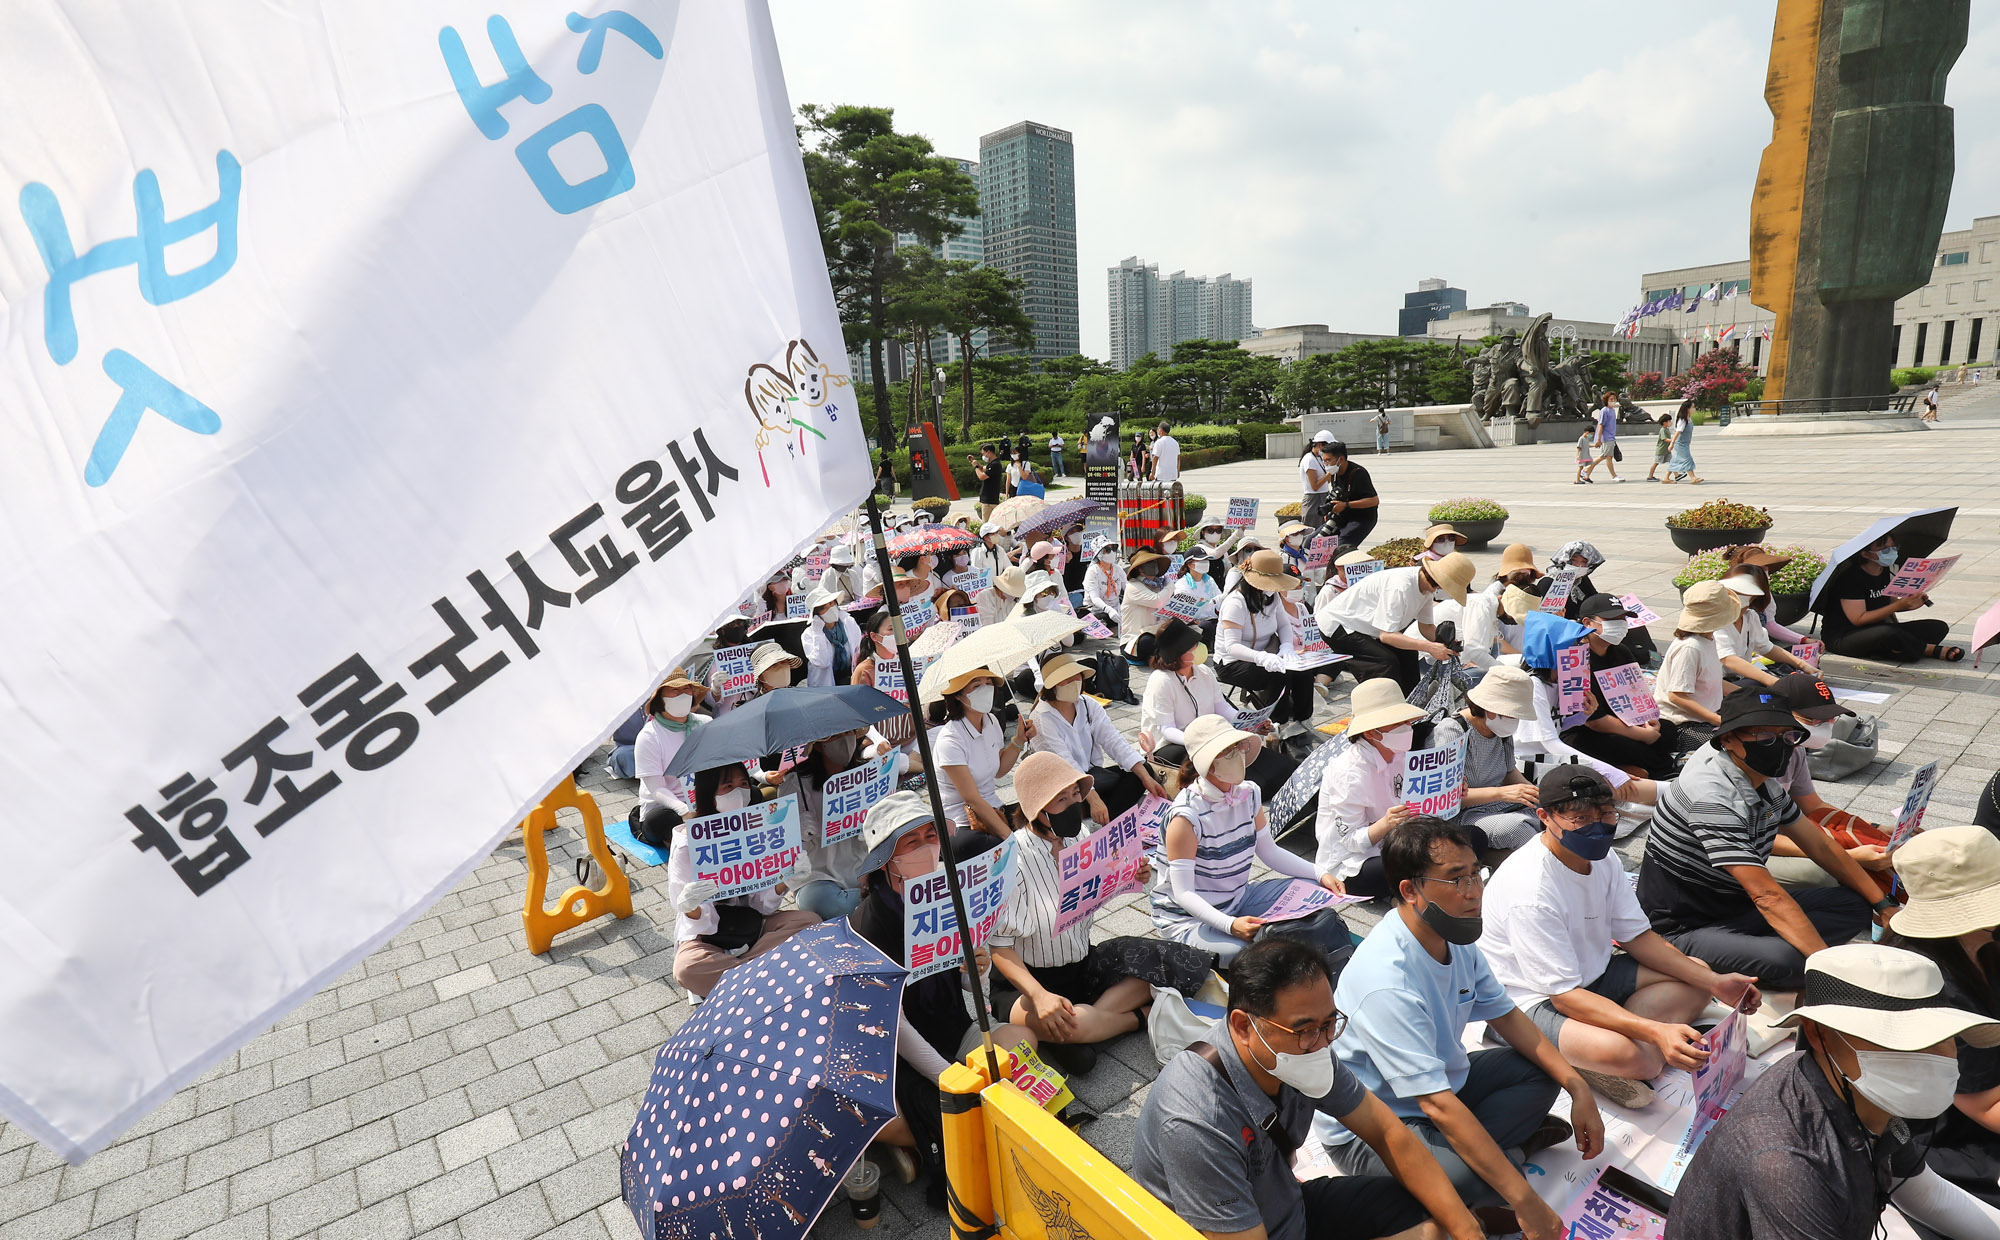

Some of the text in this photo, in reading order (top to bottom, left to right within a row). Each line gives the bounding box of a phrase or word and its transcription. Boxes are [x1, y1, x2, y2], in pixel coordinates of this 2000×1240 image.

[1228, 507, 1254, 517] 지금 당장
[1230, 499, 1250, 507] 어린이는
[953, 571, 979, 584] 어린이는
[972, 577, 988, 589] 당장
[1893, 576, 1926, 590] 즉각
[1550, 584, 1567, 596] 지금
[789, 605, 806, 616] 지금
[912, 608, 932, 624] 당장
[1166, 600, 1198, 617] 지금 당장
[878, 674, 905, 688] 지금
[1608, 693, 1634, 714] 즉각
[1408, 747, 1457, 772] 어린이는
[826, 766, 878, 796] 어린이는
[1406, 771, 1443, 796] 지금
[827, 774, 891, 817] 지금 당장
[690, 811, 764, 841] 어린이는
[695, 825, 786, 867] 지금 당장
[1062, 811, 1138, 882] 만5세취학
[1060, 874, 1102, 915] 즉각
[911, 875, 1004, 938] 지금 당장
